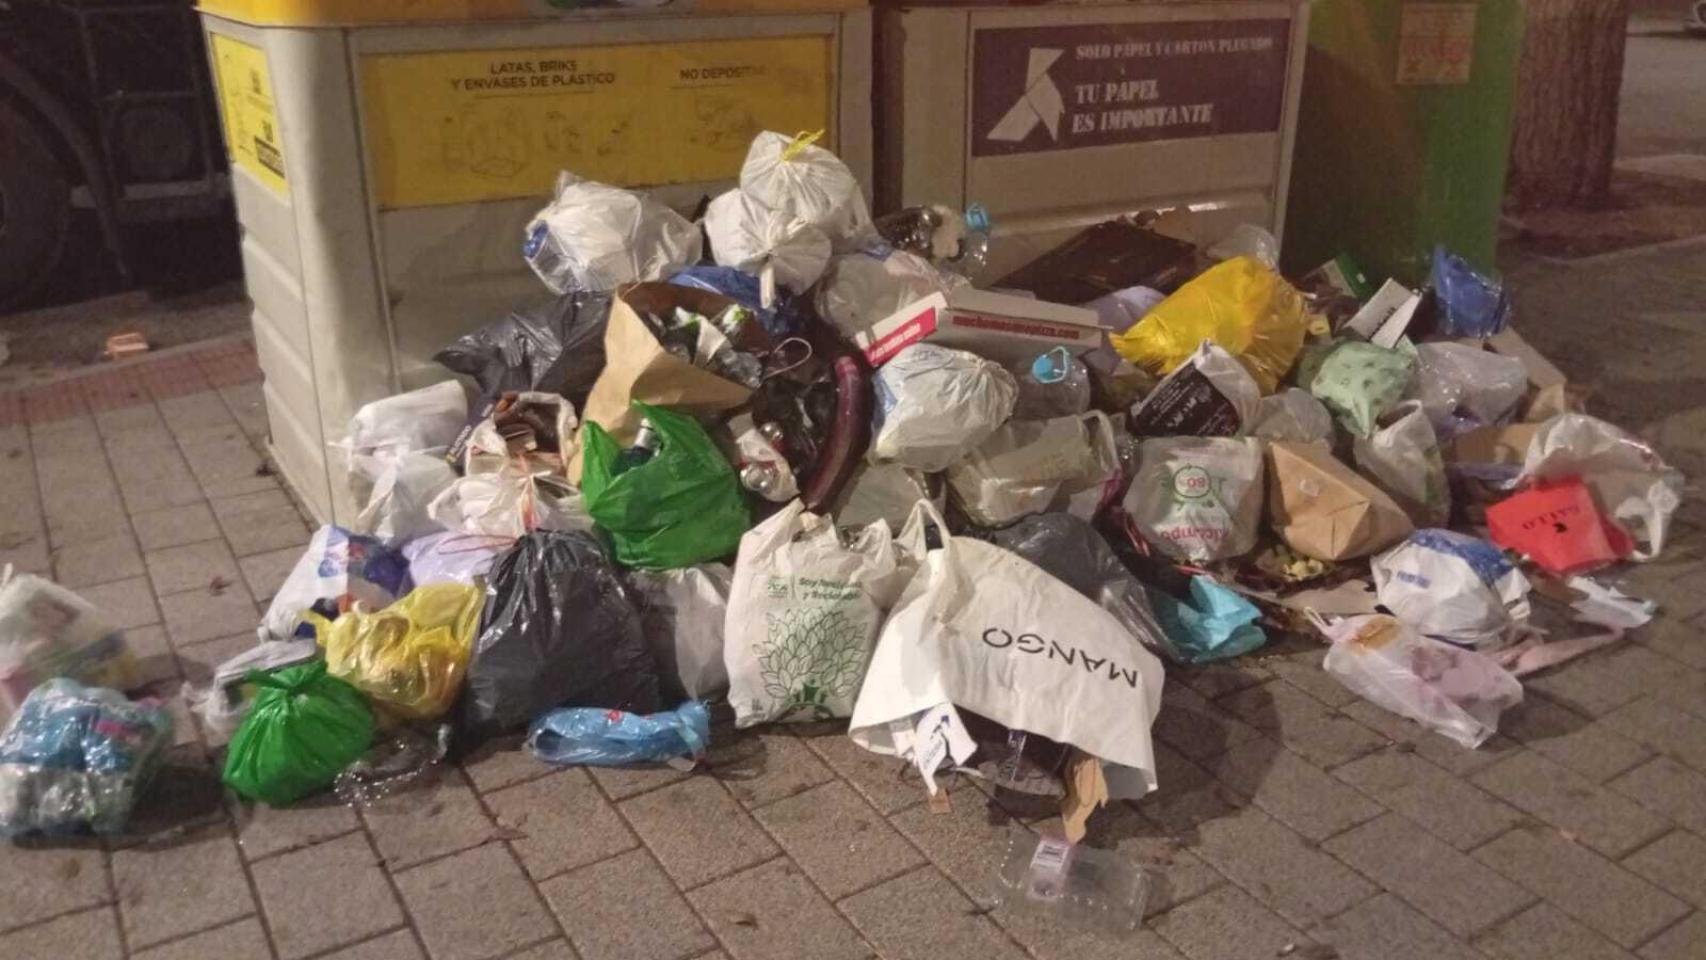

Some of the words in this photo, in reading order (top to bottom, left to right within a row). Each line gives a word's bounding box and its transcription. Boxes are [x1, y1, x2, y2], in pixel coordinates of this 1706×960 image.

[539, 60, 577, 73] BRIKS
[679, 69, 699, 80] NO
[452, 79, 459, 90] Y
[464, 76, 527, 90] ENVASES
[531, 74, 549, 88] DE
[1075, 83, 1100, 105] TU
[1105, 80, 1160, 102] PAPEL
[1072, 113, 1096, 133] ES
[1100, 103, 1215, 131] IMPORTANTE
[982, 627, 1138, 688] MANGO
